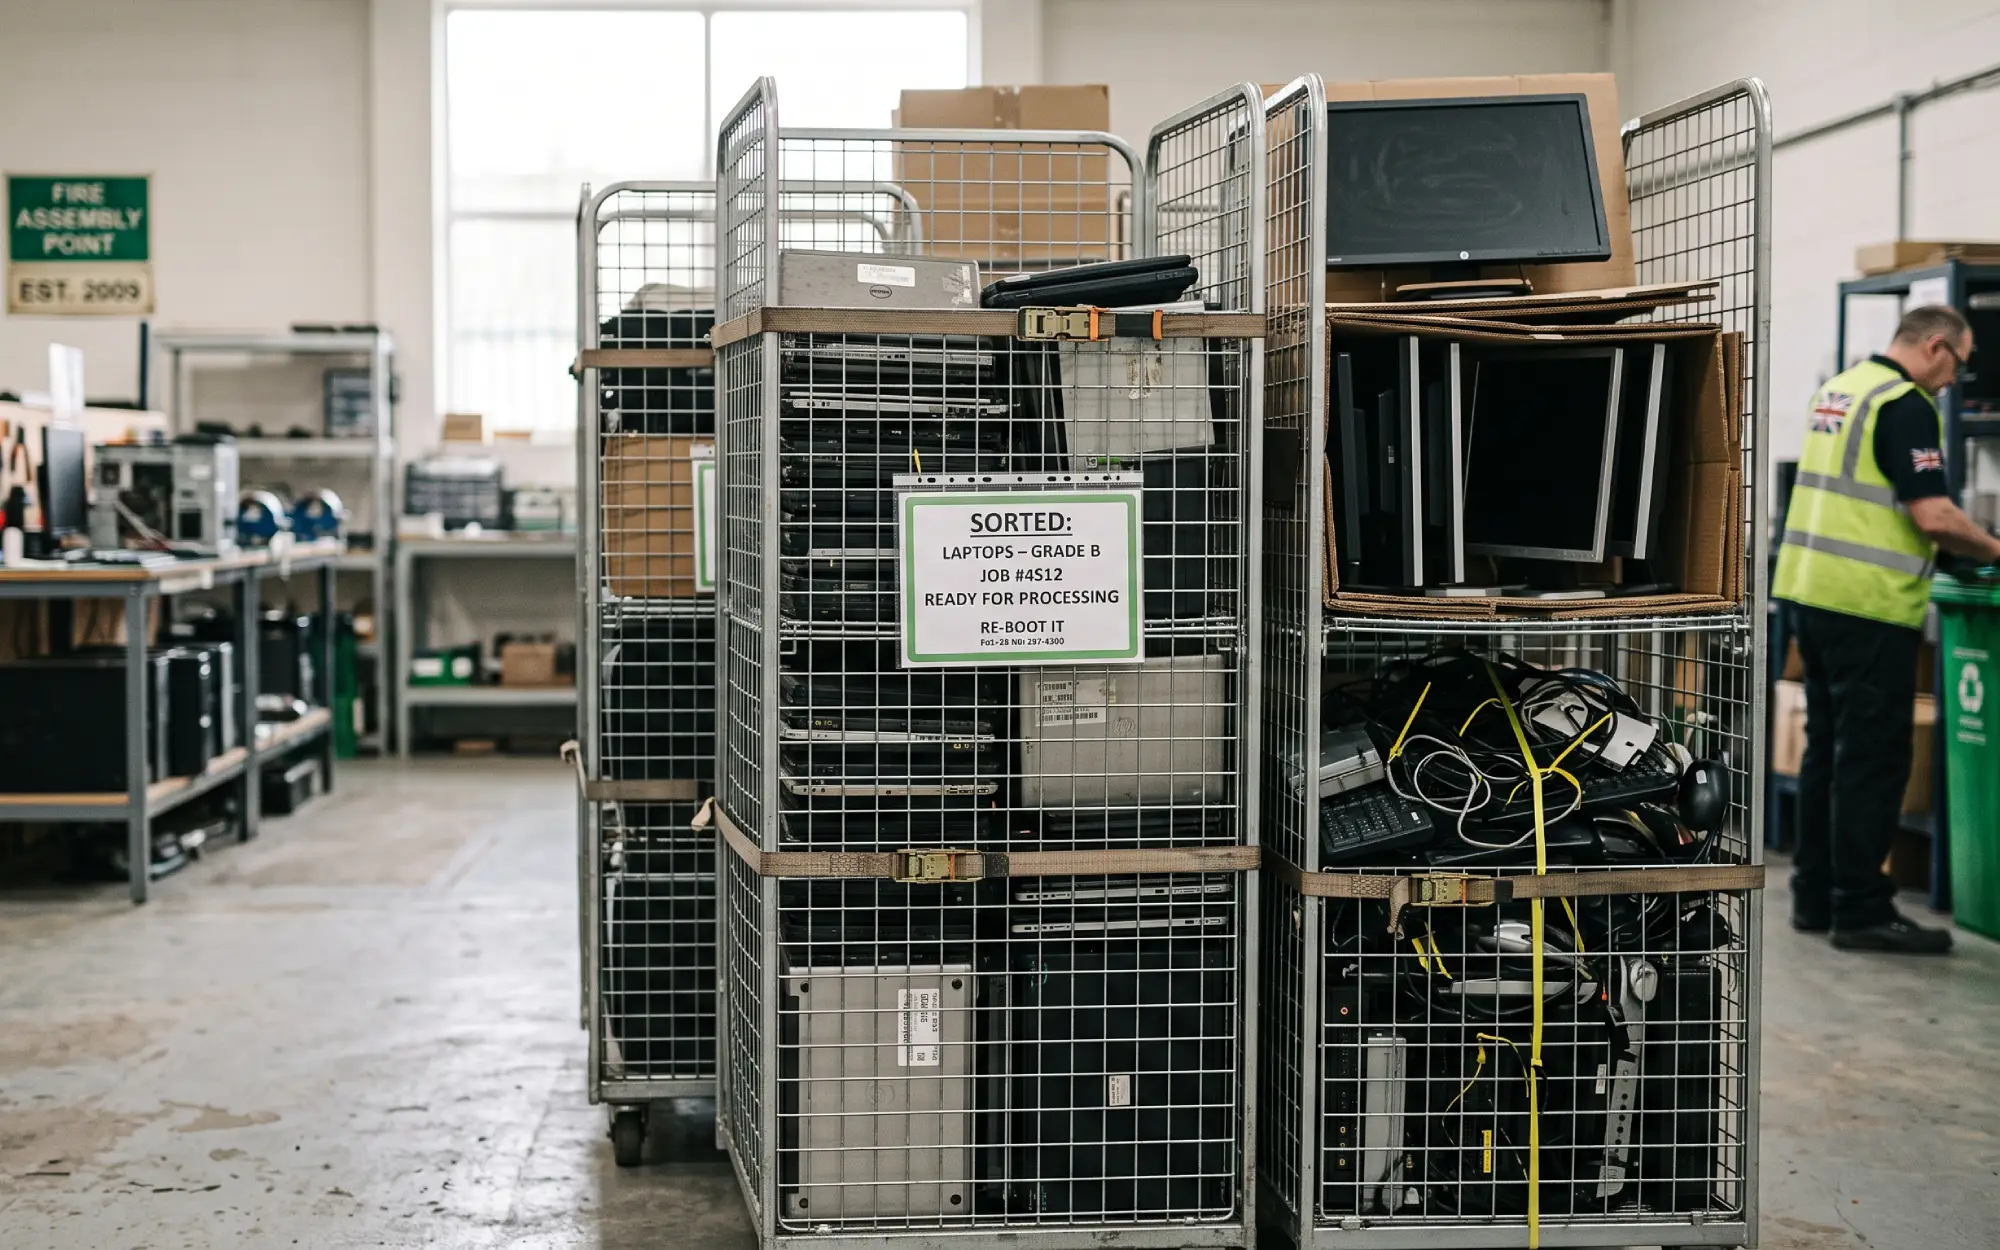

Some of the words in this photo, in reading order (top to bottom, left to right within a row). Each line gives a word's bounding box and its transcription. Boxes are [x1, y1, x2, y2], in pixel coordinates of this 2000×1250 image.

[51, 182, 105, 204] FIRE
[16, 207, 142, 230] ASSEMBLY
[43, 233, 115, 255] POINT
[82, 279, 141, 303] 2009
[970, 512, 1072, 532] SORTED:
[943, 545, 1014, 560] LAPTOPS
[1031, 544, 1085, 558] GRADE
[1090, 544, 1101, 558] B
[980, 568, 1010, 583] JOB
[925, 592, 978, 607] READY
[982, 591, 1014, 606] FOR
[1019, 589, 1119, 605] PROCESSING
[980, 620, 1048, 634] RE-BOOT
[1051, 620, 1065, 633] IT
